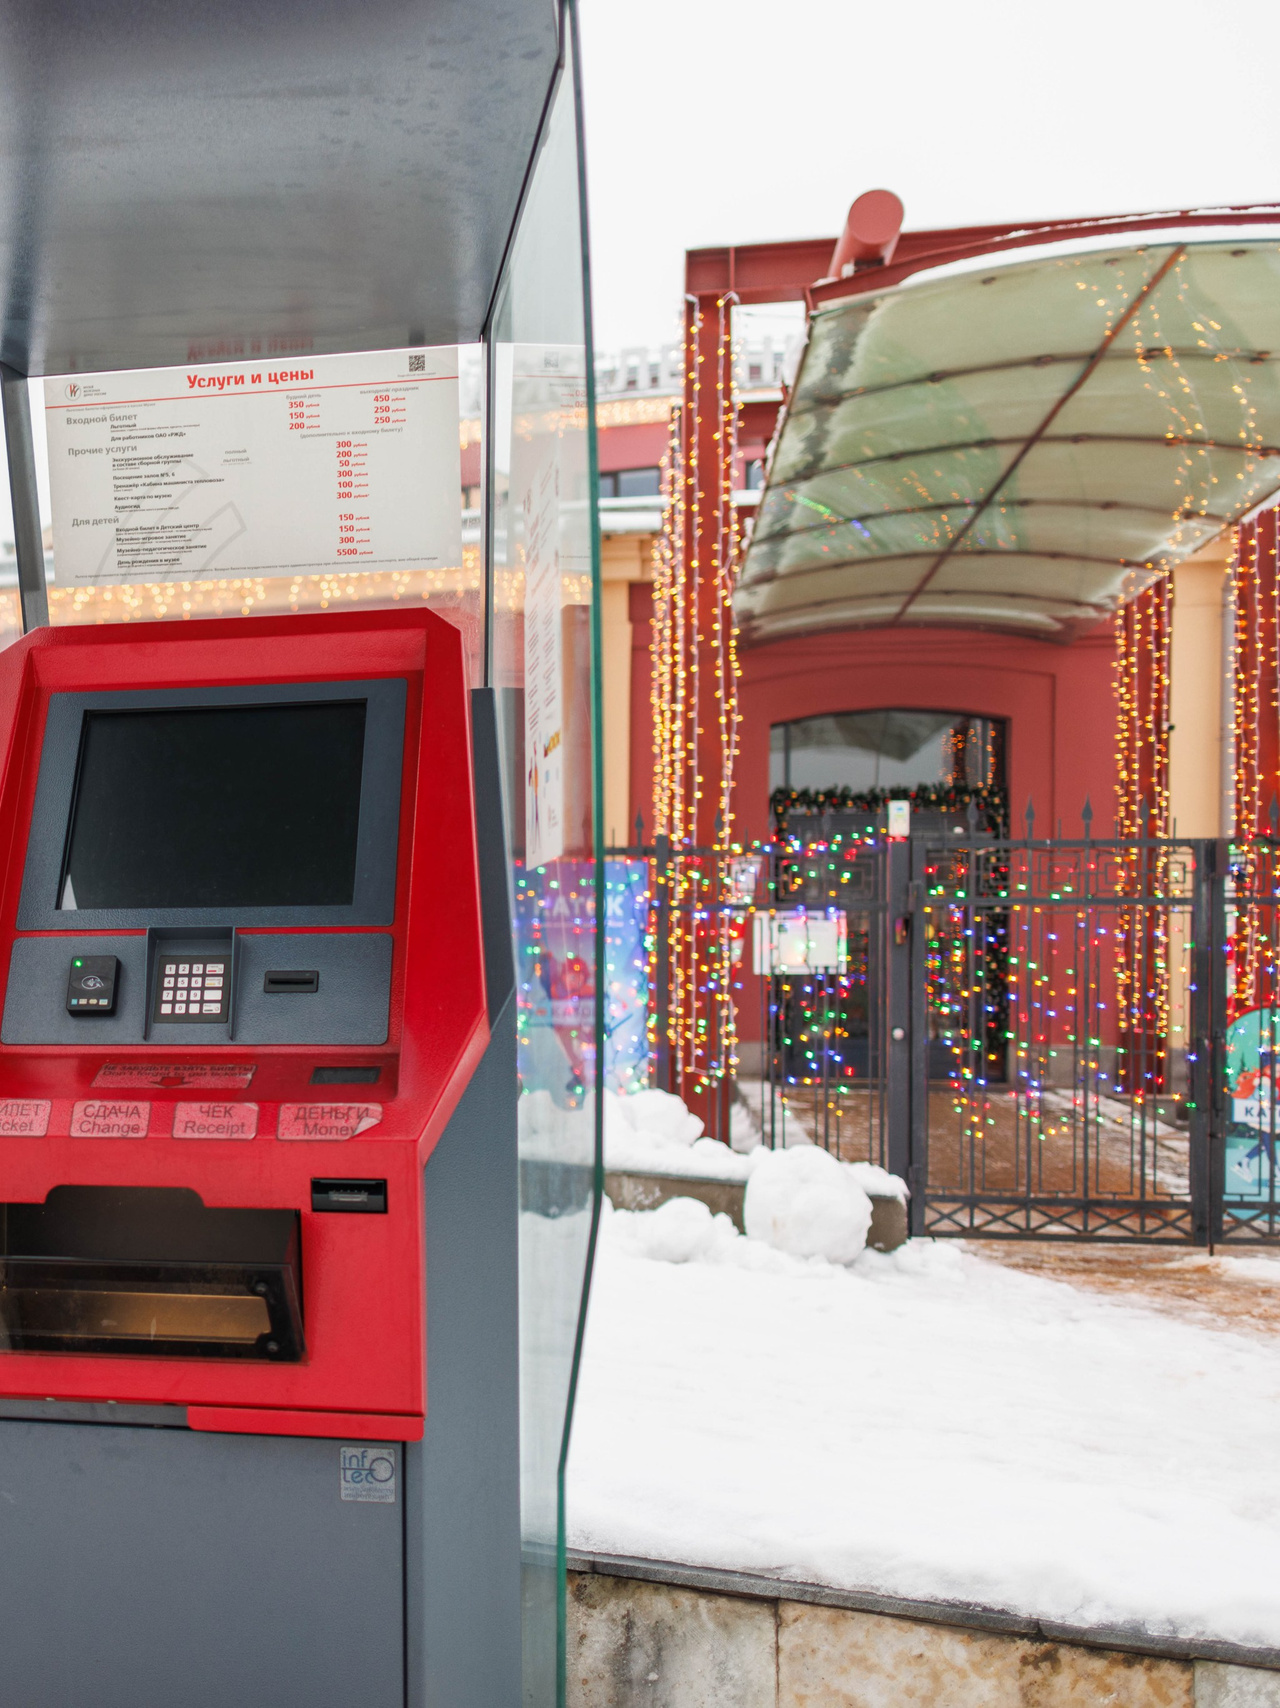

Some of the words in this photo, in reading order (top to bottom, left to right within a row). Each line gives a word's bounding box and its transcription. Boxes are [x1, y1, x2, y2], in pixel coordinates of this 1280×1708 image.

[187, 374, 245, 390] Услуги
[251, 373, 261, 384] и
[268, 369, 314, 385] цены
[66, 415, 107, 425] Входной
[109, 413, 138, 422] билет
[68, 447, 103, 457] Прочие
[105, 445, 137, 455] услуги
[337, 470, 353, 478] 300
[72, 518, 90, 527] Для
[92, 516, 119, 526] детей
[339, 536, 355, 544] 300
[337, 548, 358, 556] 5500
[83, 1104, 141, 1120] СДАЧА
[199, 1105, 235, 1118] ЧЕК
[294, 1106, 370, 1122] ДЕНЬГИ
[1245, 1106, 1280, 1118] КА
[79, 1120, 141, 1136] Change
[183, 1121, 246, 1137] Receipt
[303, 1123, 357, 1136] Money
